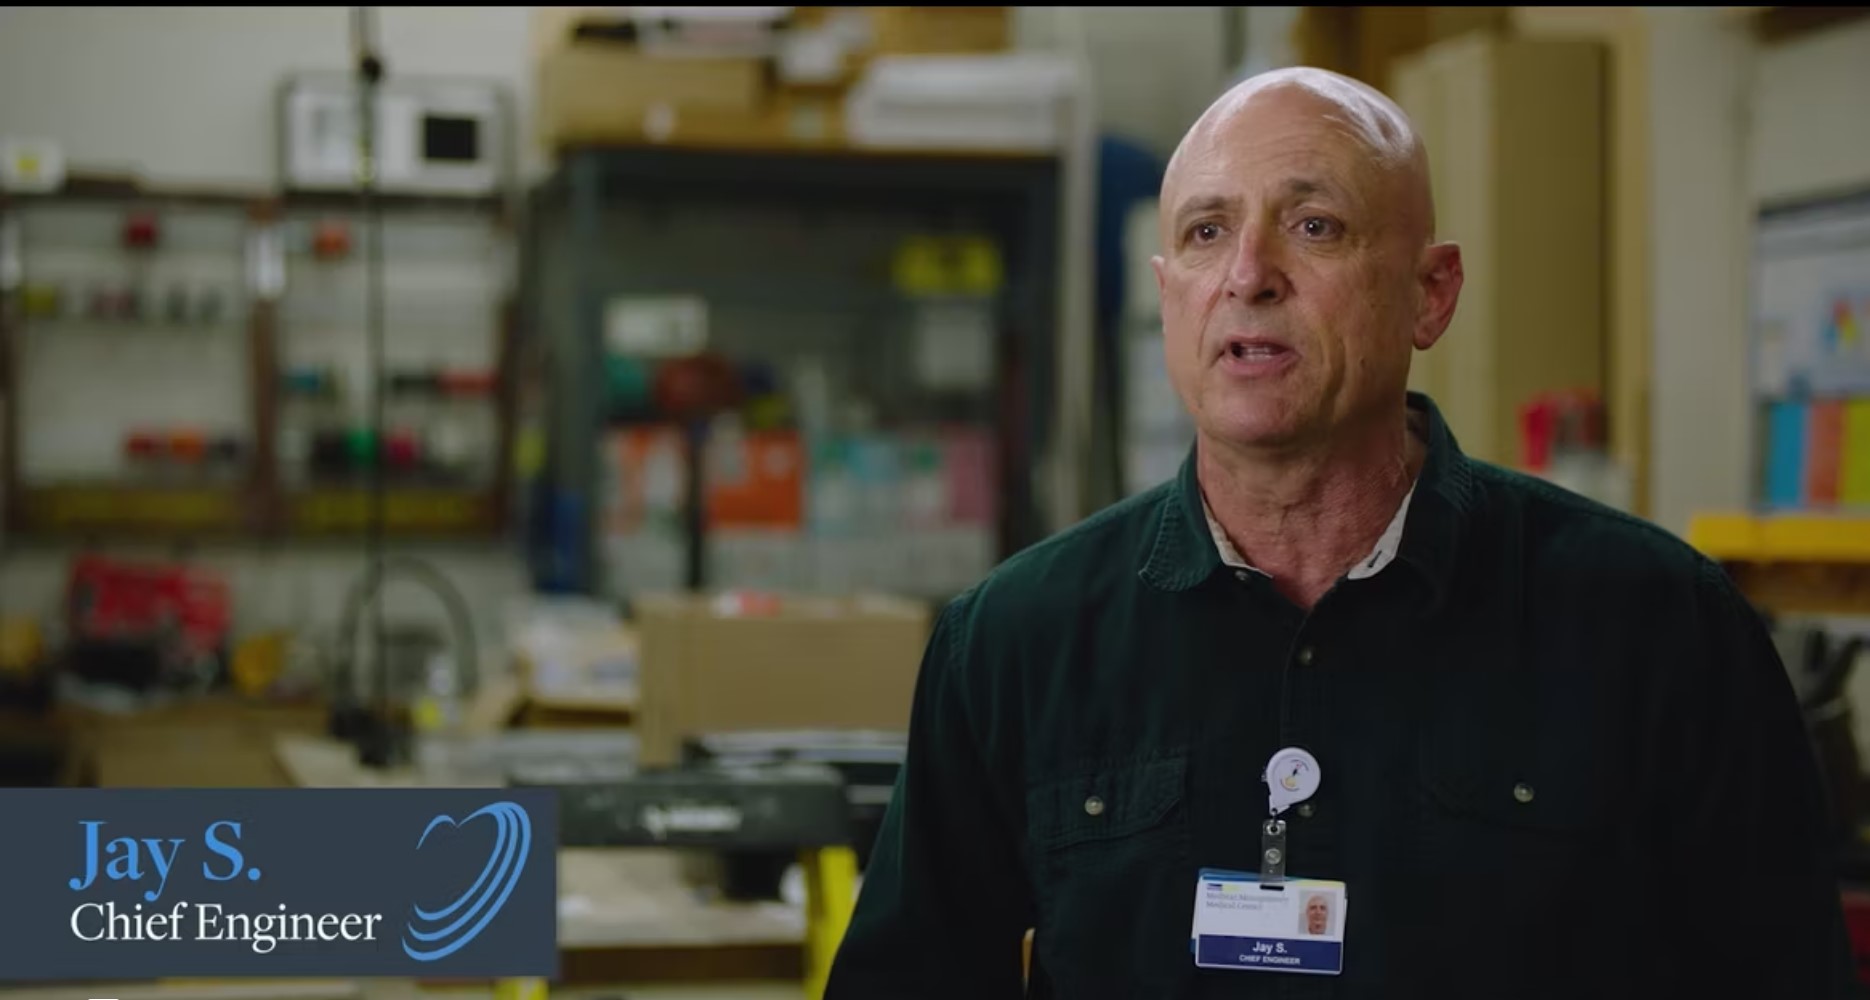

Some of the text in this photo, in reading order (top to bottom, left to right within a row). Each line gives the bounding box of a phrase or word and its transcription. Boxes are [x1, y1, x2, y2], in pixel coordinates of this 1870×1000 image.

[1252, 941, 1288, 955] Jay S.
[1239, 954, 1301, 965] CHIEF ENGINEER
